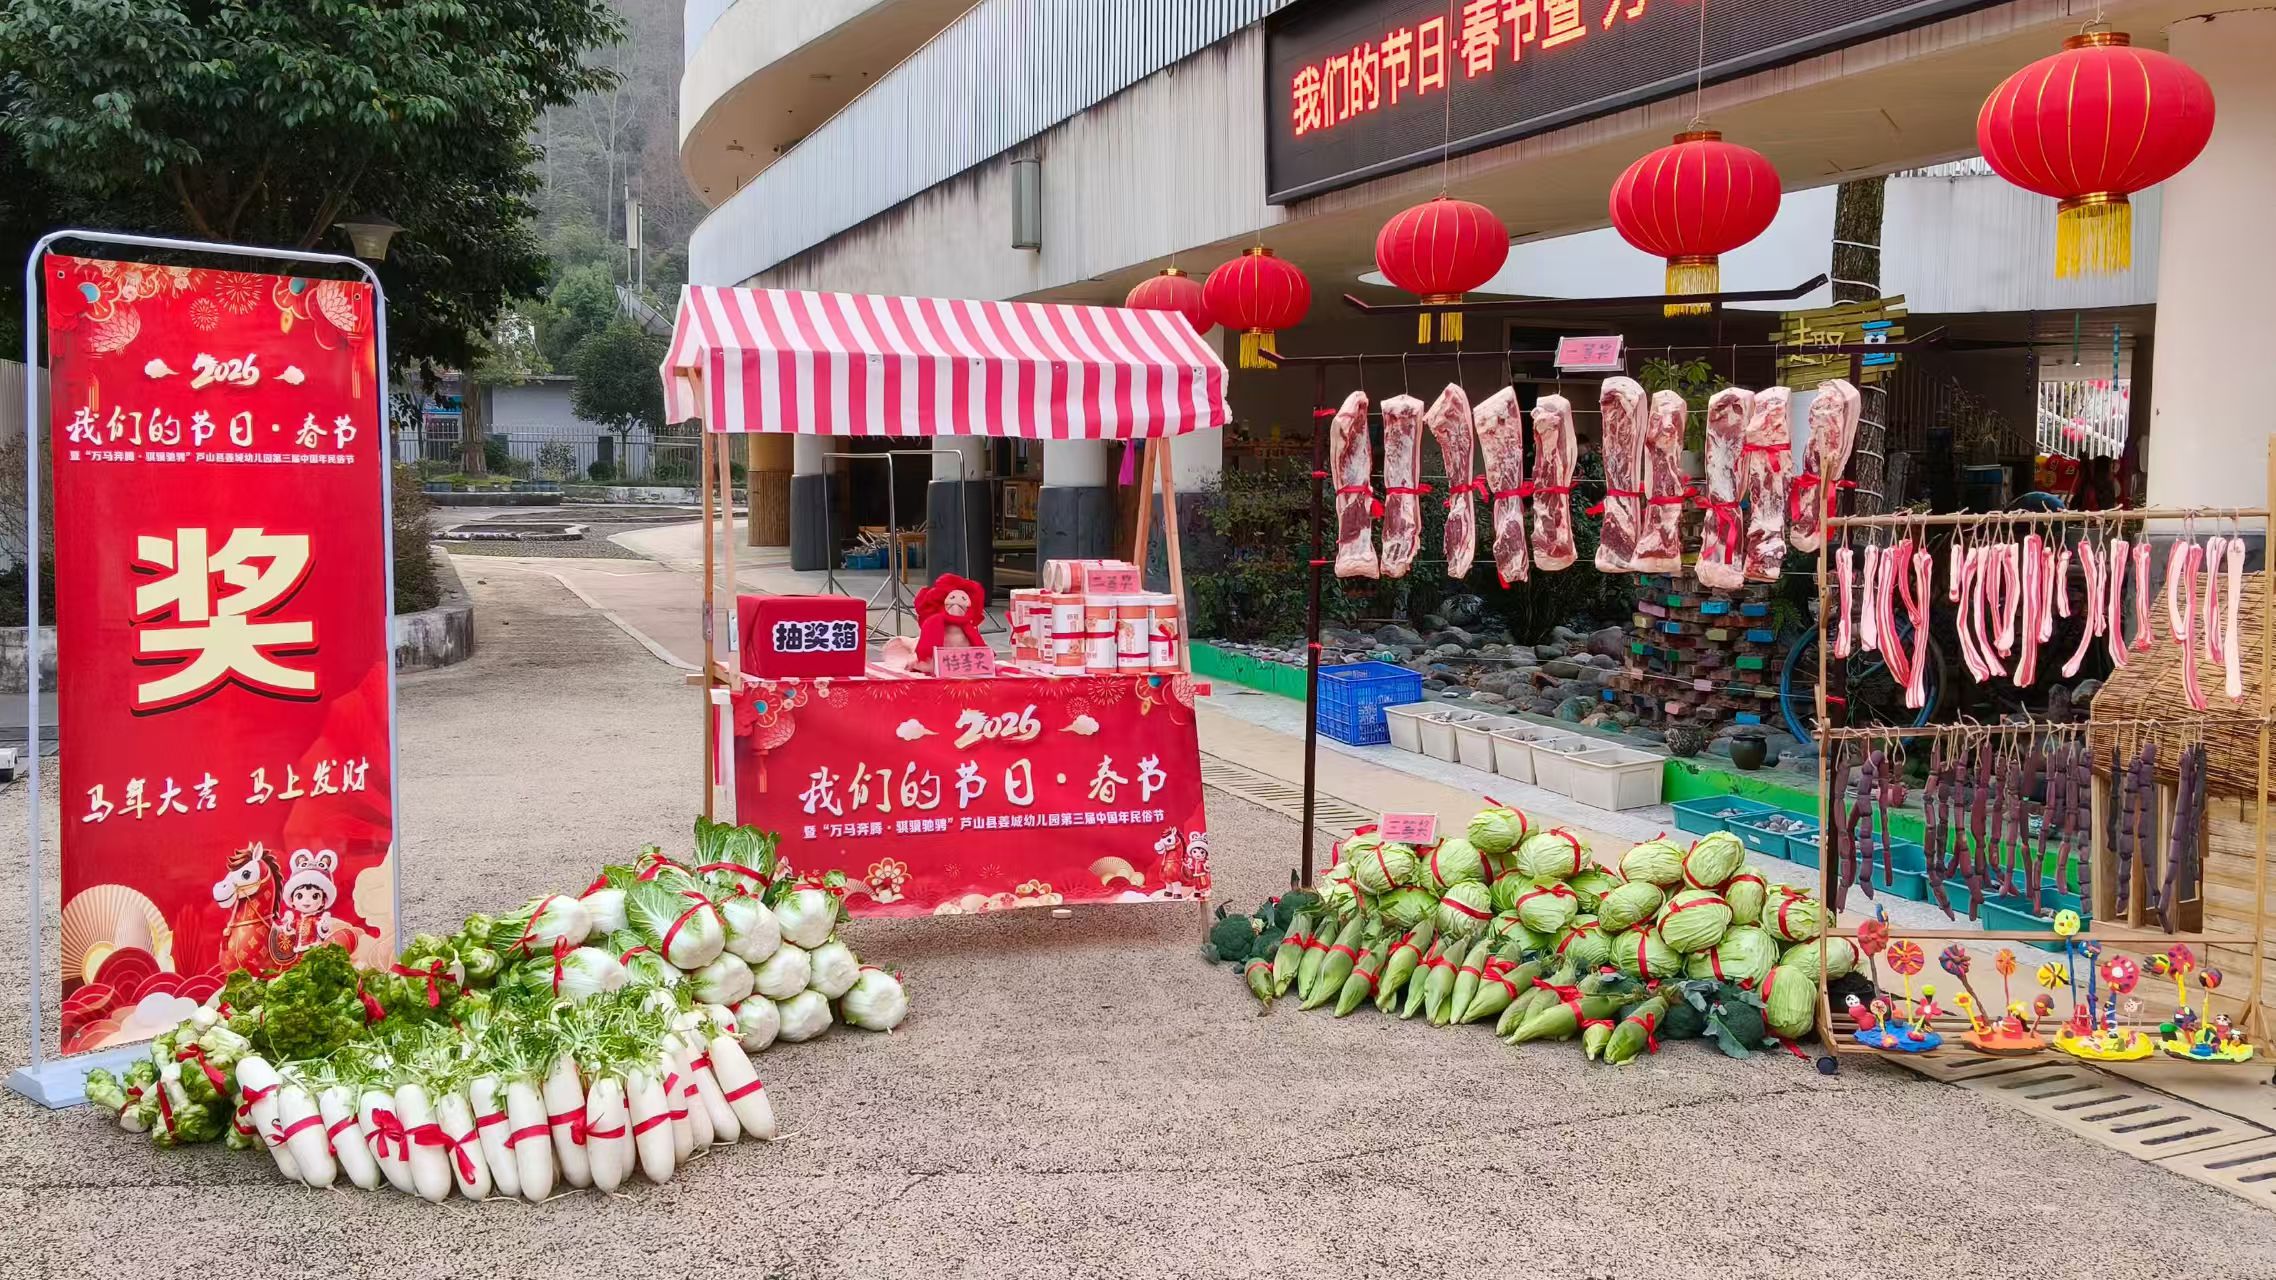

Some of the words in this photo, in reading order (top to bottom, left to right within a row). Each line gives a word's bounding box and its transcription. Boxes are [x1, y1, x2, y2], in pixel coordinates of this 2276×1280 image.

[191, 352, 260, 389] 2026
[66, 405, 357, 449] 我们的节日·春节
[135, 527, 316, 705] 奖
[774, 621, 857, 651] 抽奖箱
[942, 652, 989, 672] 特等奖
[954, 704, 1041, 749] 2026
[82, 772, 219, 823] 马年大吉
[245, 756, 370, 804] 马上发财
[798, 754, 1168, 815] 我们的节日·春节
